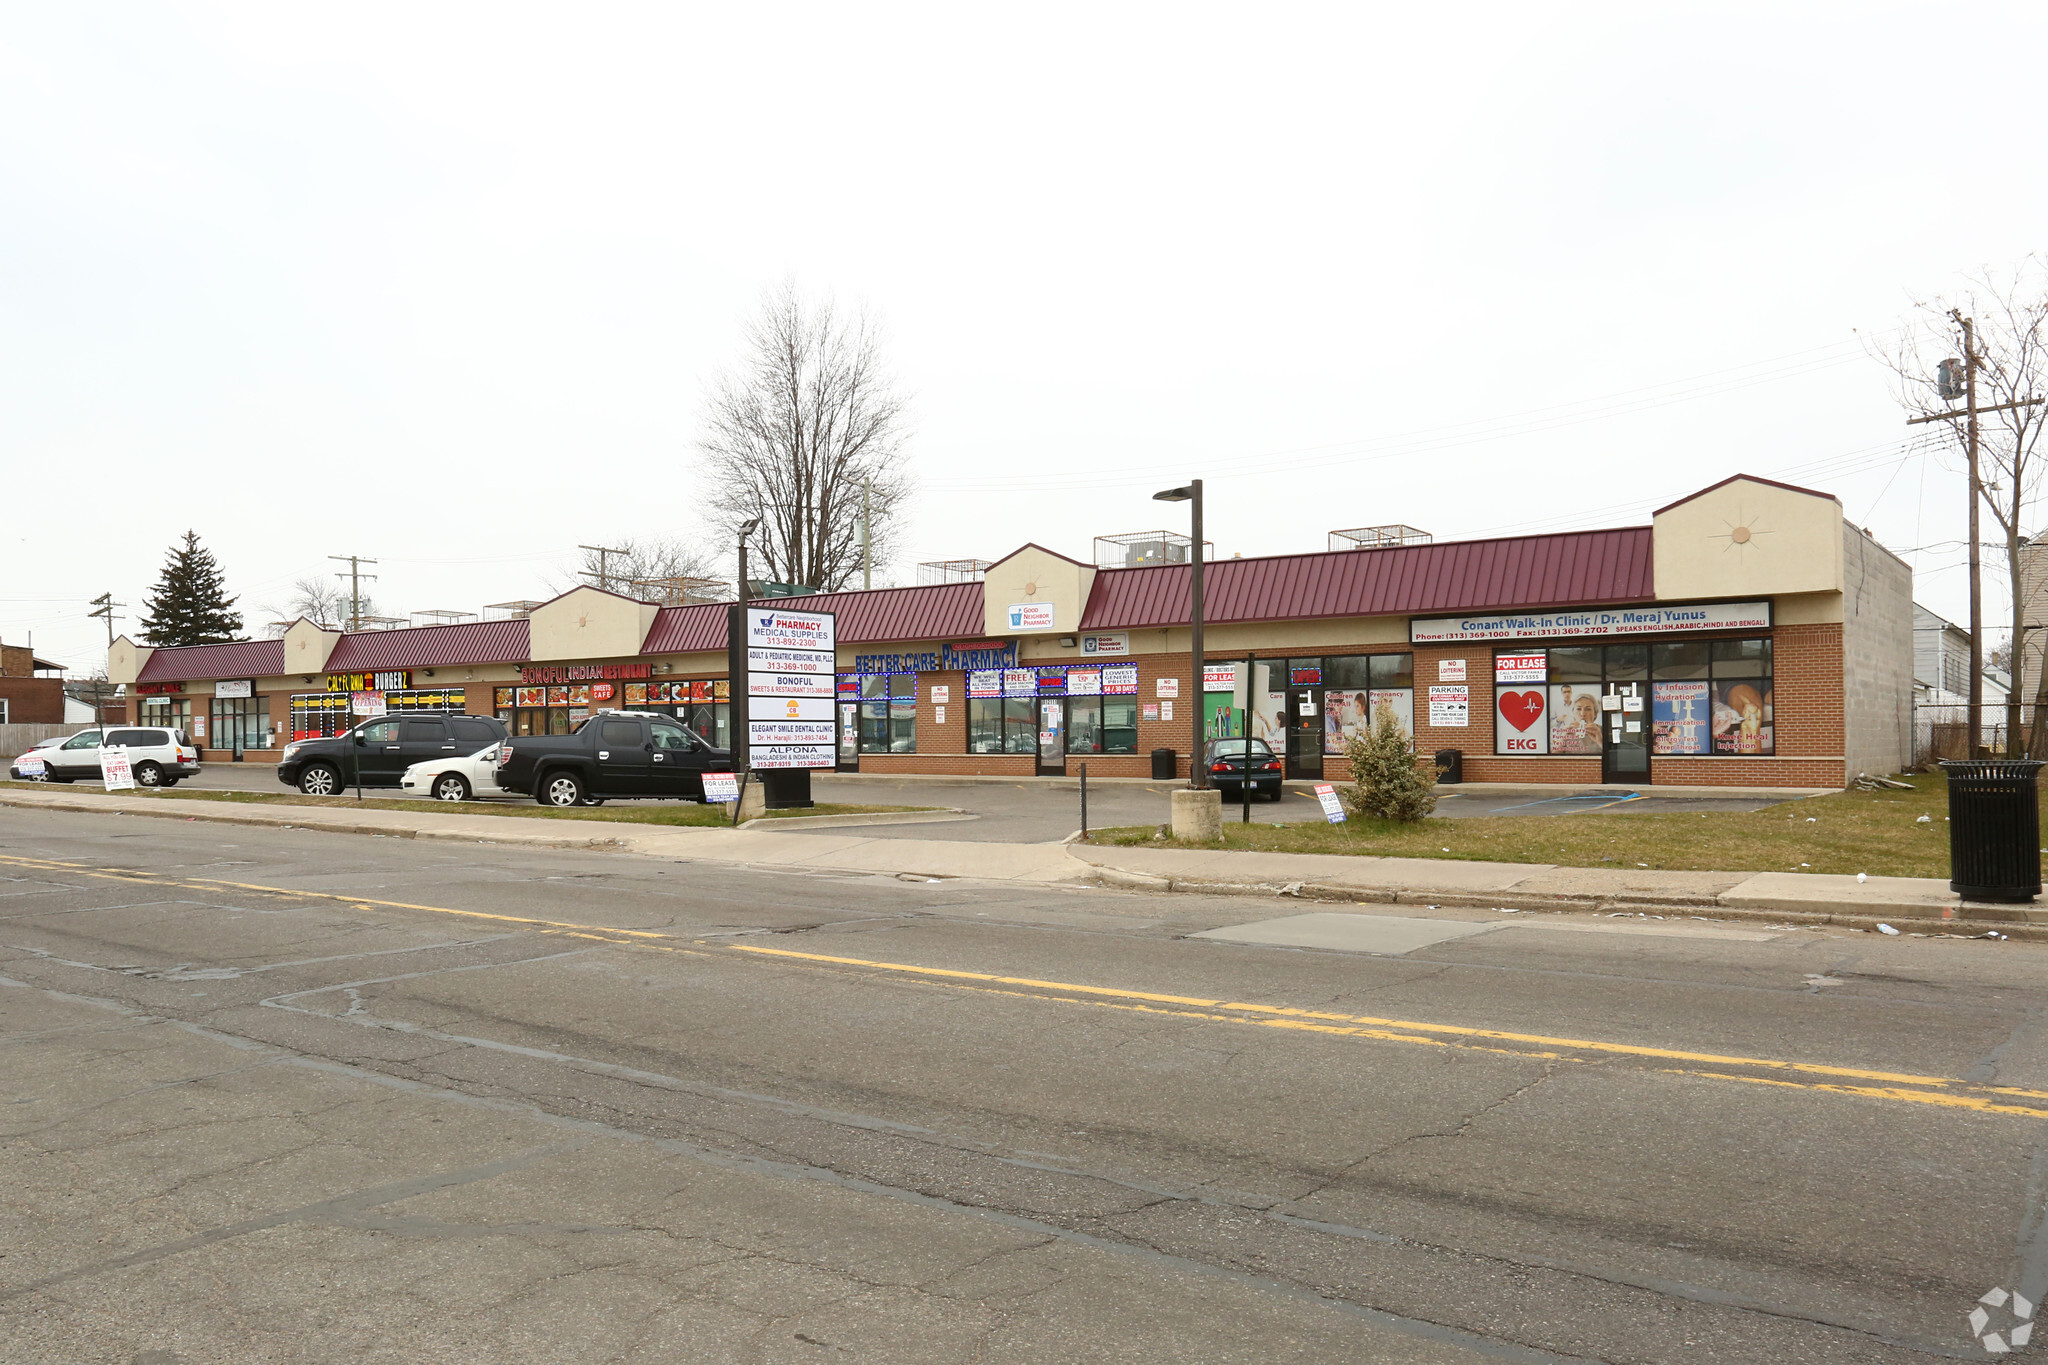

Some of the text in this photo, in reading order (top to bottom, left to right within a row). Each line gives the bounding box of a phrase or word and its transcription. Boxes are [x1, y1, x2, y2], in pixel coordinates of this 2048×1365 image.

[1462, 621, 1504, 631] Conant
[1506, 617, 1552, 628] Walk-In
[1556, 615, 1590, 626] Clinic
[1601, 614, 1619, 624] Dr.
[1623, 611, 1661, 624] Meraj
[1664, 610, 1706, 621] Yunus
[776, 620, 821, 631] PHARMACY
[754, 628, 828, 639] MEDICAL SUPPLIES
[1470, 631, 1510, 639] 369-1000
[767, 637, 816, 646] 313-892-2300
[750, 651, 764, 659] ADULT
[770, 652, 791, 660] PEDIATRIC
[855, 640, 1019, 672] BETTER CARE PHARMACY
[767, 662, 817, 671] 313-369-1000
[1497, 659, 1545, 669] FOR LEASE
[522, 664, 652, 684] BONOFUL INDIAN RESTAURANT
[374, 671, 408, 690] BURGERZ
[777, 677, 813, 685] BONOFUL
[1666, 683, 1706, 691] Infusion/
[1655, 694, 1696, 702] Hydration
[1507, 739, 1537, 750] EKG
[106, 765, 128, 773] BUFFET
[106, 773, 131, 781] $7.99
